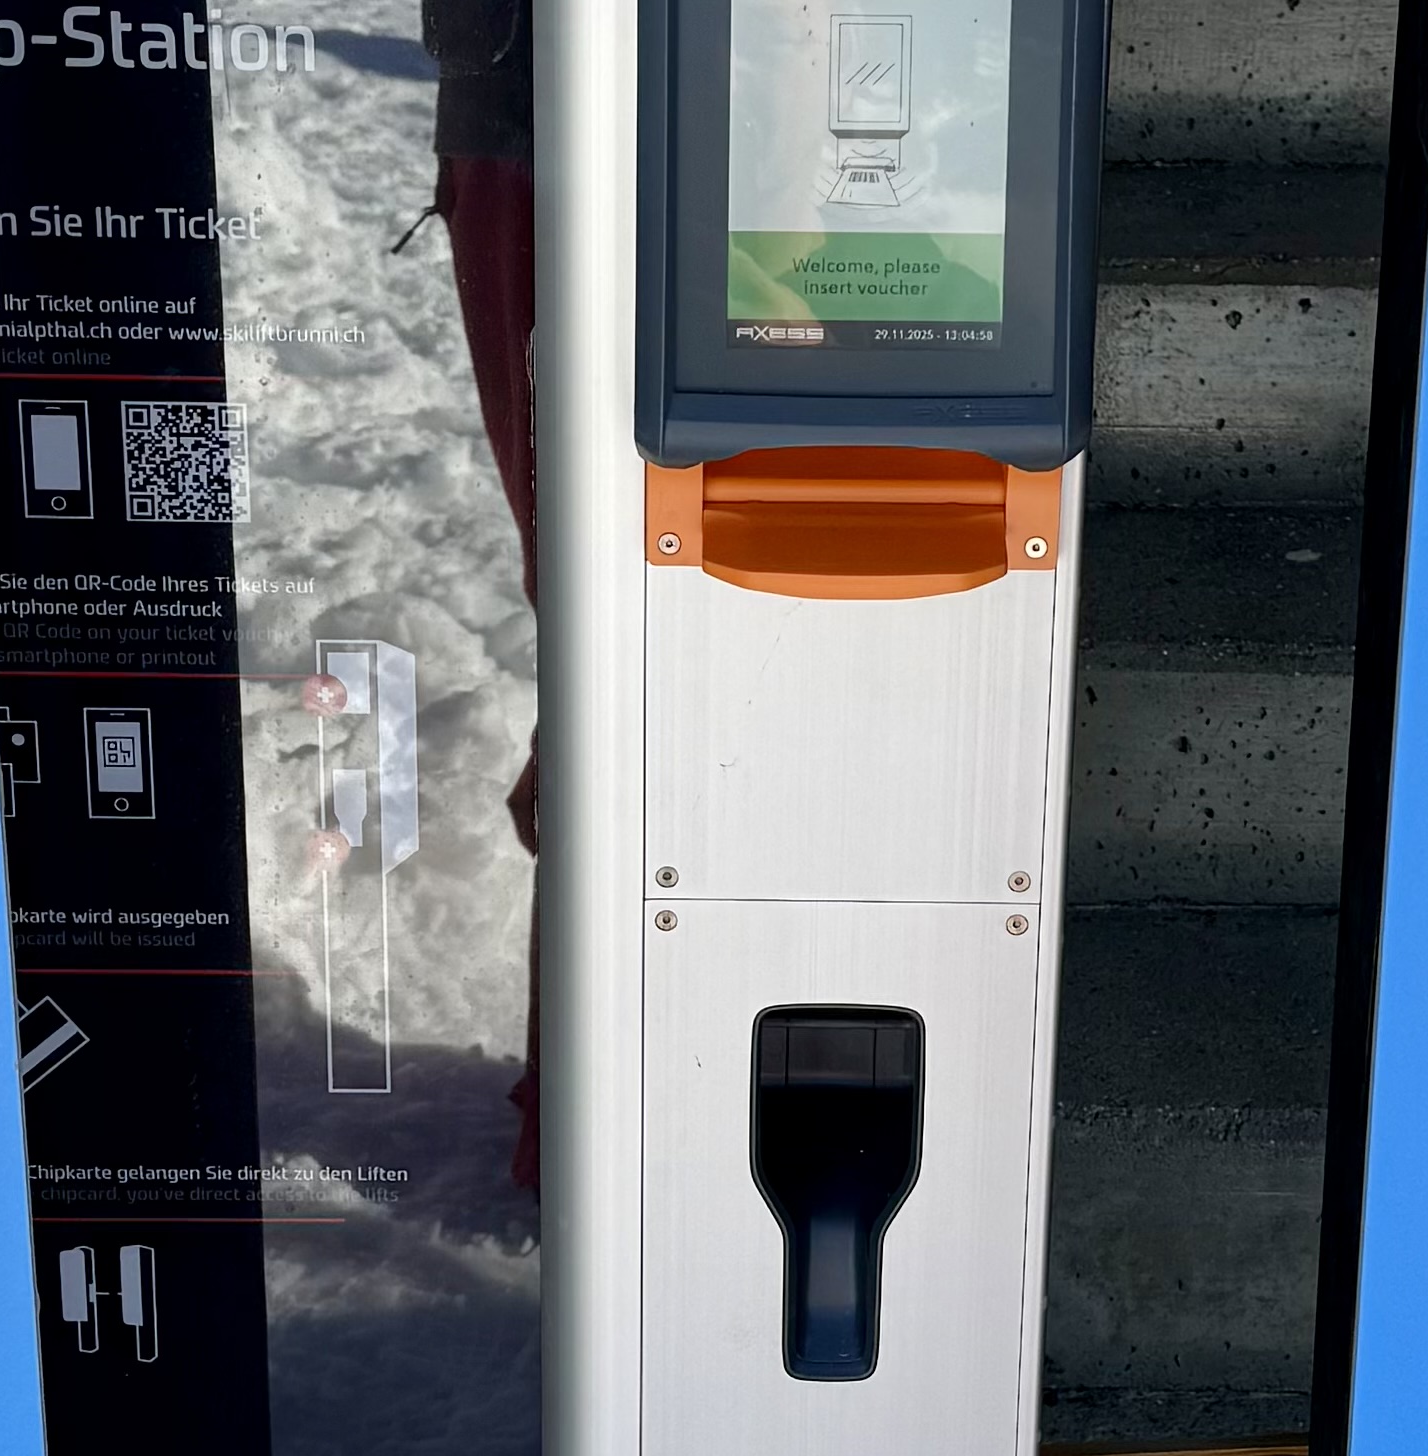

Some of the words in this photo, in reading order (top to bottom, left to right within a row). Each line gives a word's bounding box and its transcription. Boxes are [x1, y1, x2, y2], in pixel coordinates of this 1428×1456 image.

[30, 205, 83, 238] Sie
[95, 205, 144, 238] Ihr
[154, 207, 262, 241] Ticket
[792, 257, 878, 276] Welcome,
[884, 257, 941, 278] please
[804, 279, 852, 295] insert
[858, 280, 929, 296] voucher
[4, 293, 30, 312] Ihr
[36, 294, 93, 313] Ticket
[99, 295, 159, 315] online
[165, 297, 198, 316] auf
[118, 322, 163, 341] oder
[168, 323, 366, 345] www.skiliftbrunni.ch
[736, 325, 825, 342] AXESS
[52, 347, 112, 366] online
[0, 572, 28, 591] Sie
[33, 573, 69, 592] den
[74, 574, 157, 593] QR-Code
[162, 575, 209, 593] Ihres
[215, 576, 280, 594] Tickets
[285, 577, 317, 595] auf
[84, 600, 127, 617] oder
[133, 600, 224, 618] Ausdruck
[3, 622, 29, 640] QR
[35, 622, 82, 641] Code
[88, 626, 111, 641] on
[117, 626, 160, 645] your
[166, 624, 216, 643] ticket
[116, 651, 134, 666] or
[141, 649, 218, 669] printout
[72, 908, 113, 925] wird
[118, 909, 230, 929] ausgegeben
[72, 930, 104, 947] will
[109, 931, 132, 947] be
[137, 930, 196, 948] issued
[29, 1164, 112, 1184] Chipkarte
[117, 1165, 201, 1184] gelangen
[206, 1165, 233, 1182] Sie
[237, 1165, 289, 1182] direkt
[293, 1169, 314, 1182] zu
[318, 1166, 352, 1182] den
[357, 1166, 409, 1183] Liften
[189, 1186, 241, 1203] direct
